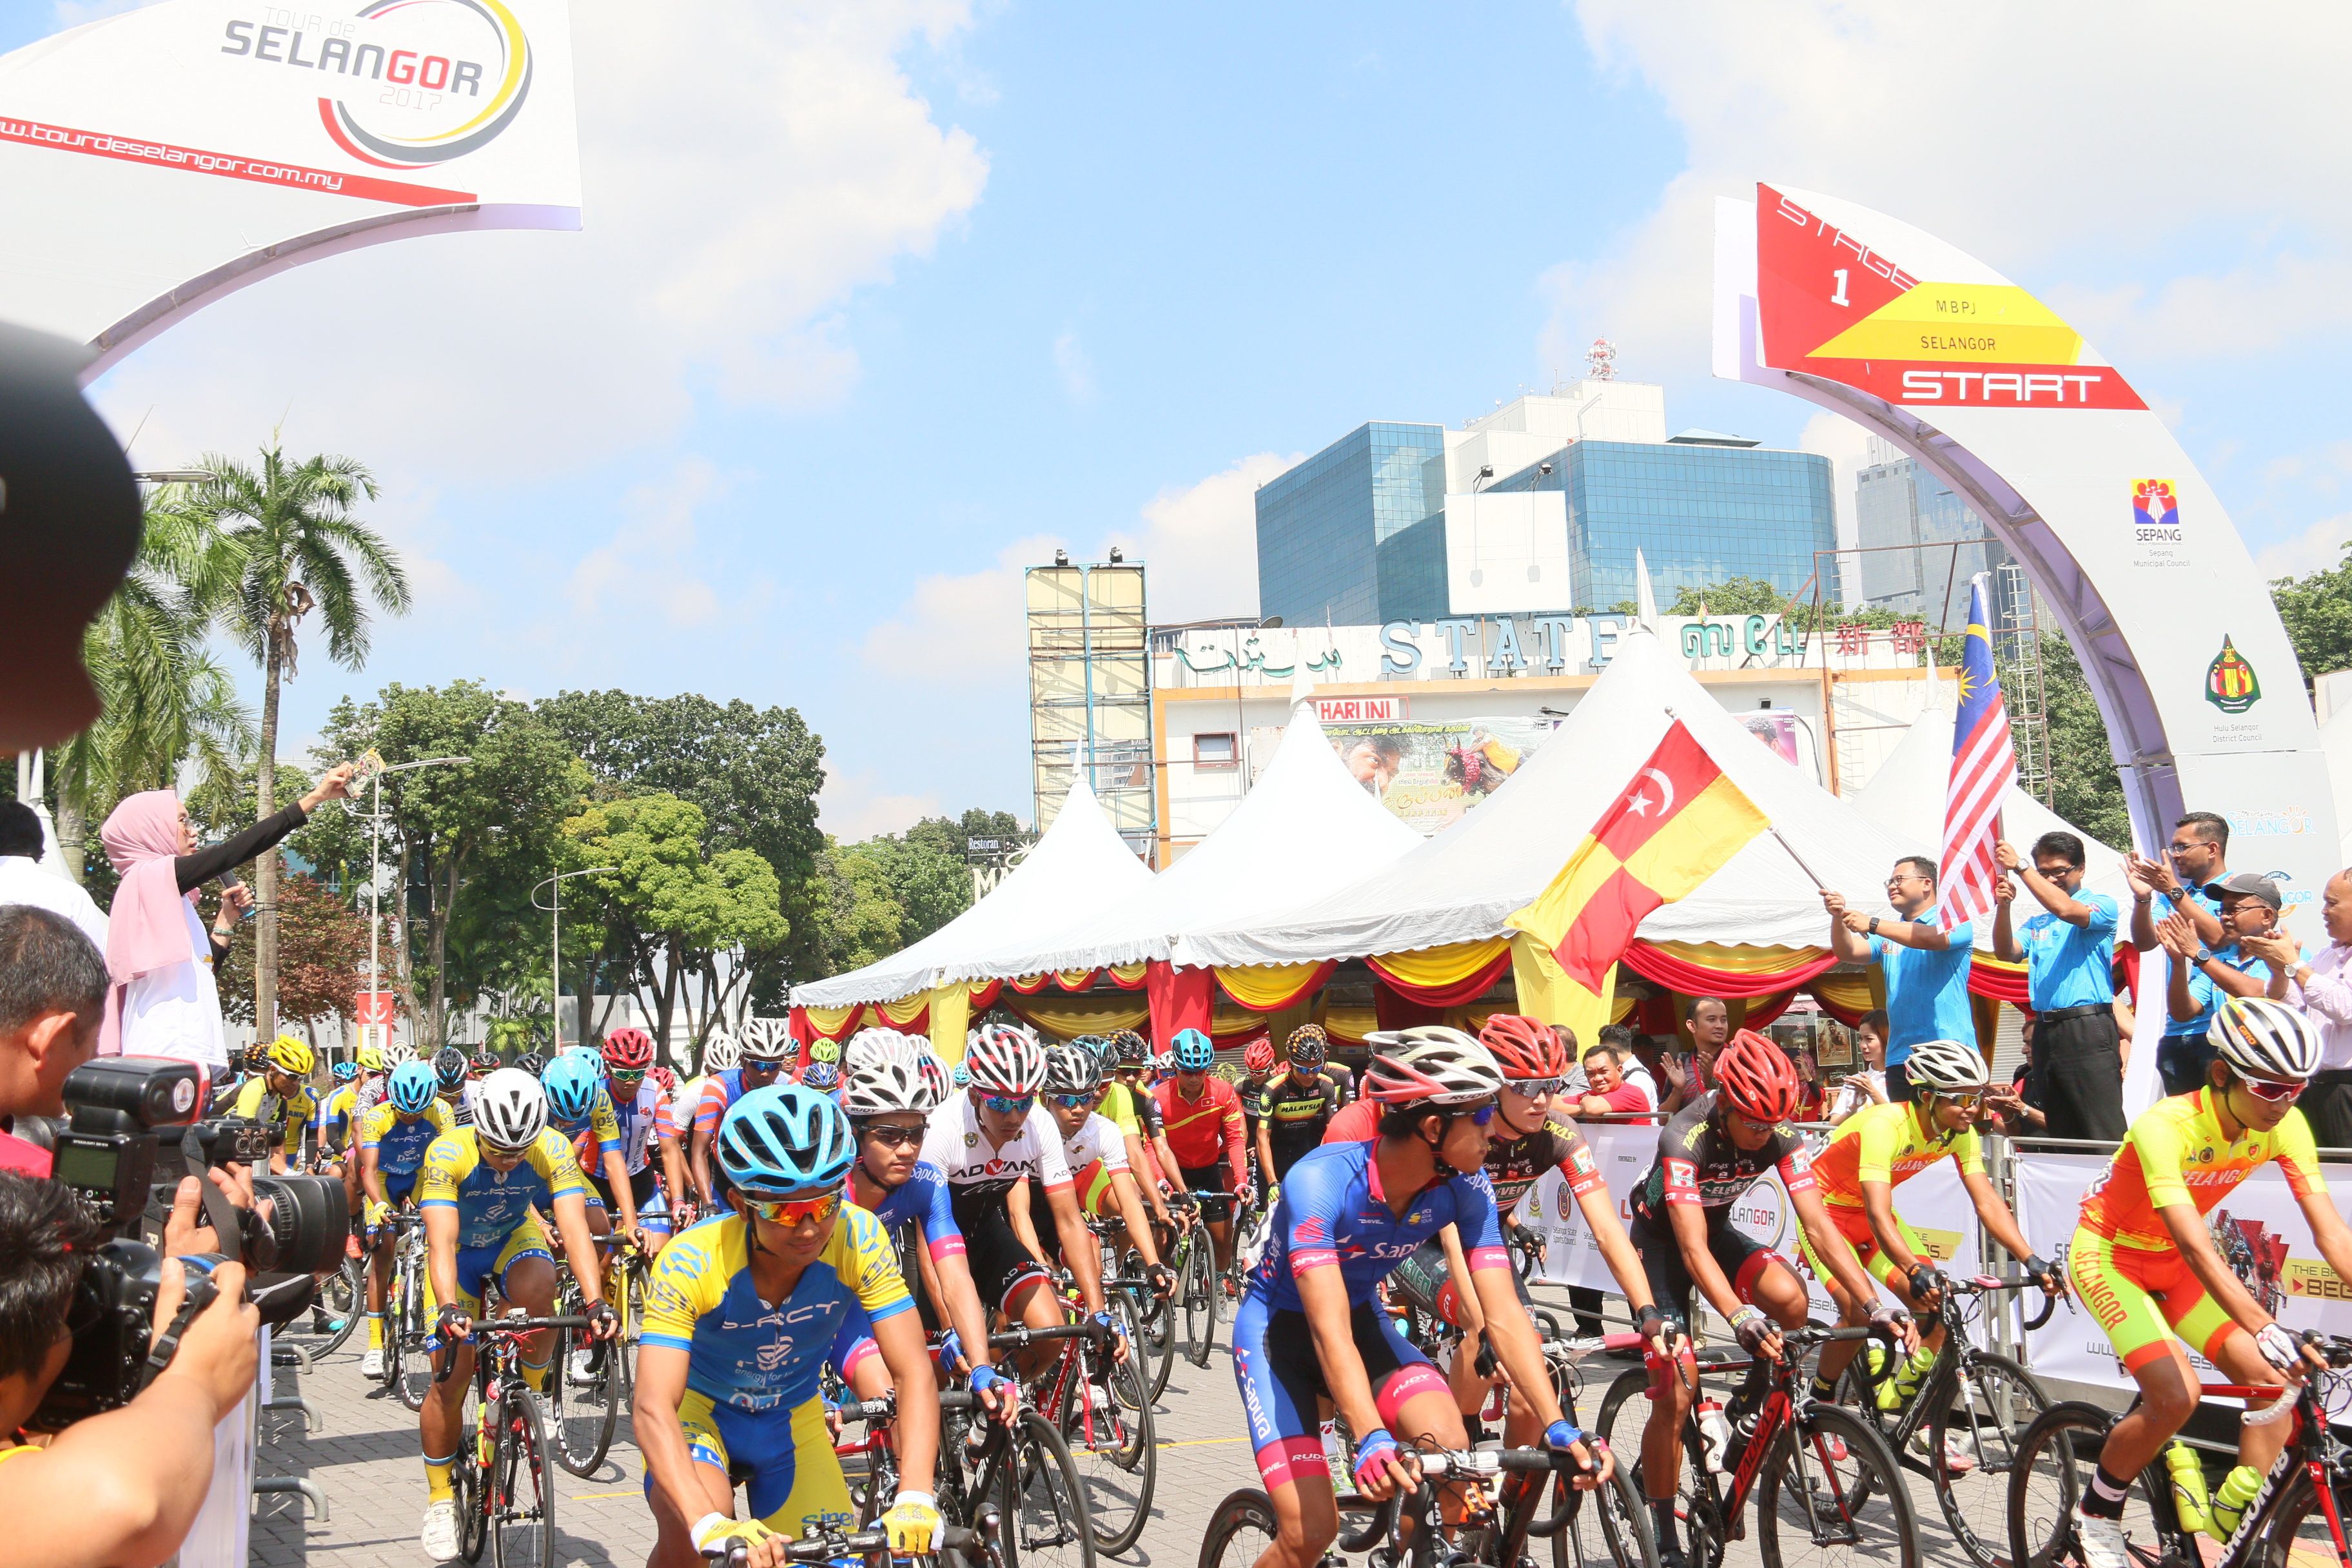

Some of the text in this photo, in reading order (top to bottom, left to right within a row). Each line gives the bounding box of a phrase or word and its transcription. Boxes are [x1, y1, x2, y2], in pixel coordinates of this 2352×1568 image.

[265, 6, 355, 39] TOUR de
[221, 20, 482, 97] SELANGOR
[379, 85, 442, 112] 2017
[1776, 195, 1921, 292] STAGE
[1831, 269, 1850, 308] 1
[1936, 300, 1976, 315] MBPJ
[1921, 336, 1996, 352] SELANGOR
[1902, 371, 2101, 402] START
[2135, 529, 2182, 541] SEPANG
[1379, 612, 1627, 674] STATE
[1320, 701, 1391, 720] HARI INI
[2226, 812, 2315, 836] SELANGOR
[968, 838, 999, 850] Restoran
[2239, 1025, 2257, 1045] GIRO
[1280, 1102, 1322, 1113] MALAYSIA
[1553, 1226, 1577, 1237] Selangor State
[1553, 1234, 1564, 1244] Sports
[1752, 1226, 1767, 1235] 2017
[2292, 1264, 2319, 1277] THE
[2074, 1250, 2128, 1332] SELANGOR
[1243, 1377, 1271, 1440] Sapura
[1291, 1453, 1326, 1462] RUDY
